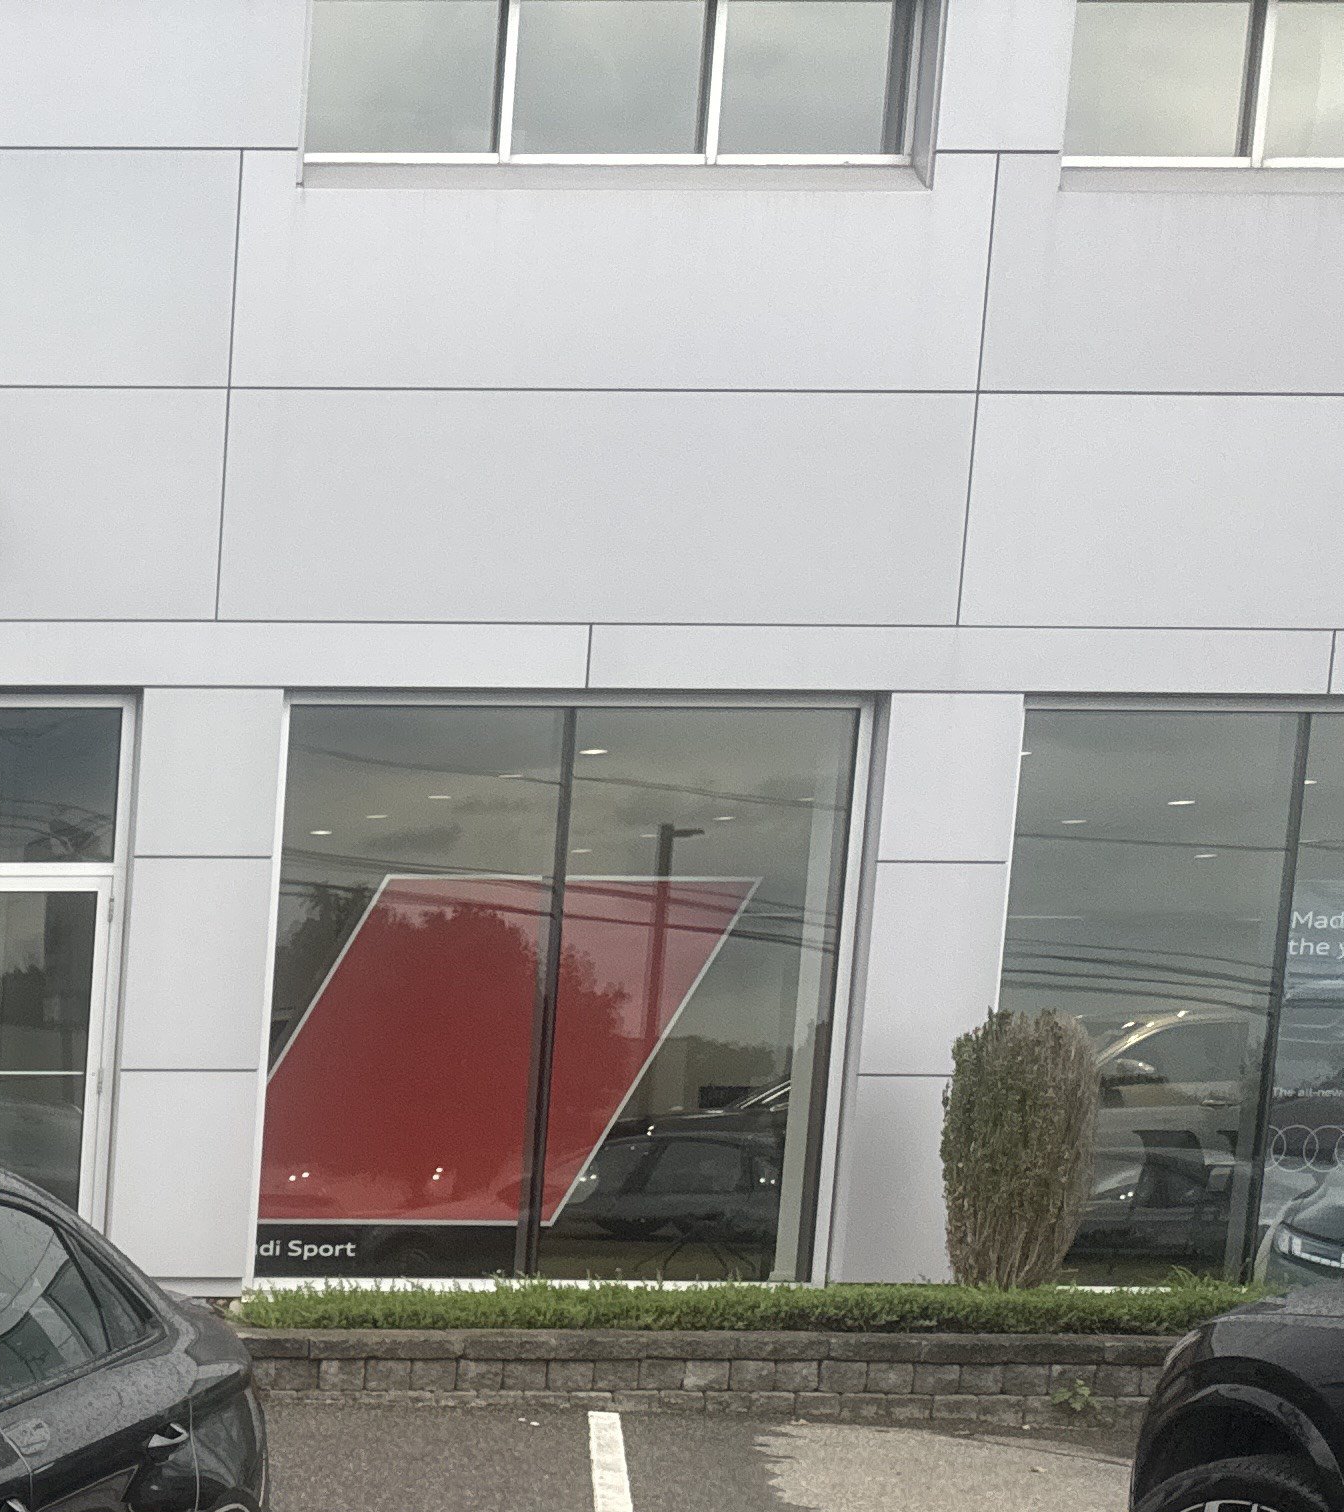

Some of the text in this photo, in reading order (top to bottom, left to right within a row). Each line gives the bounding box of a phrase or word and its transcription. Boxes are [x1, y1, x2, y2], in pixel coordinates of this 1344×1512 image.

[1288, 938, 1330, 956] the
[255, 1239, 356, 1261] di Sport
